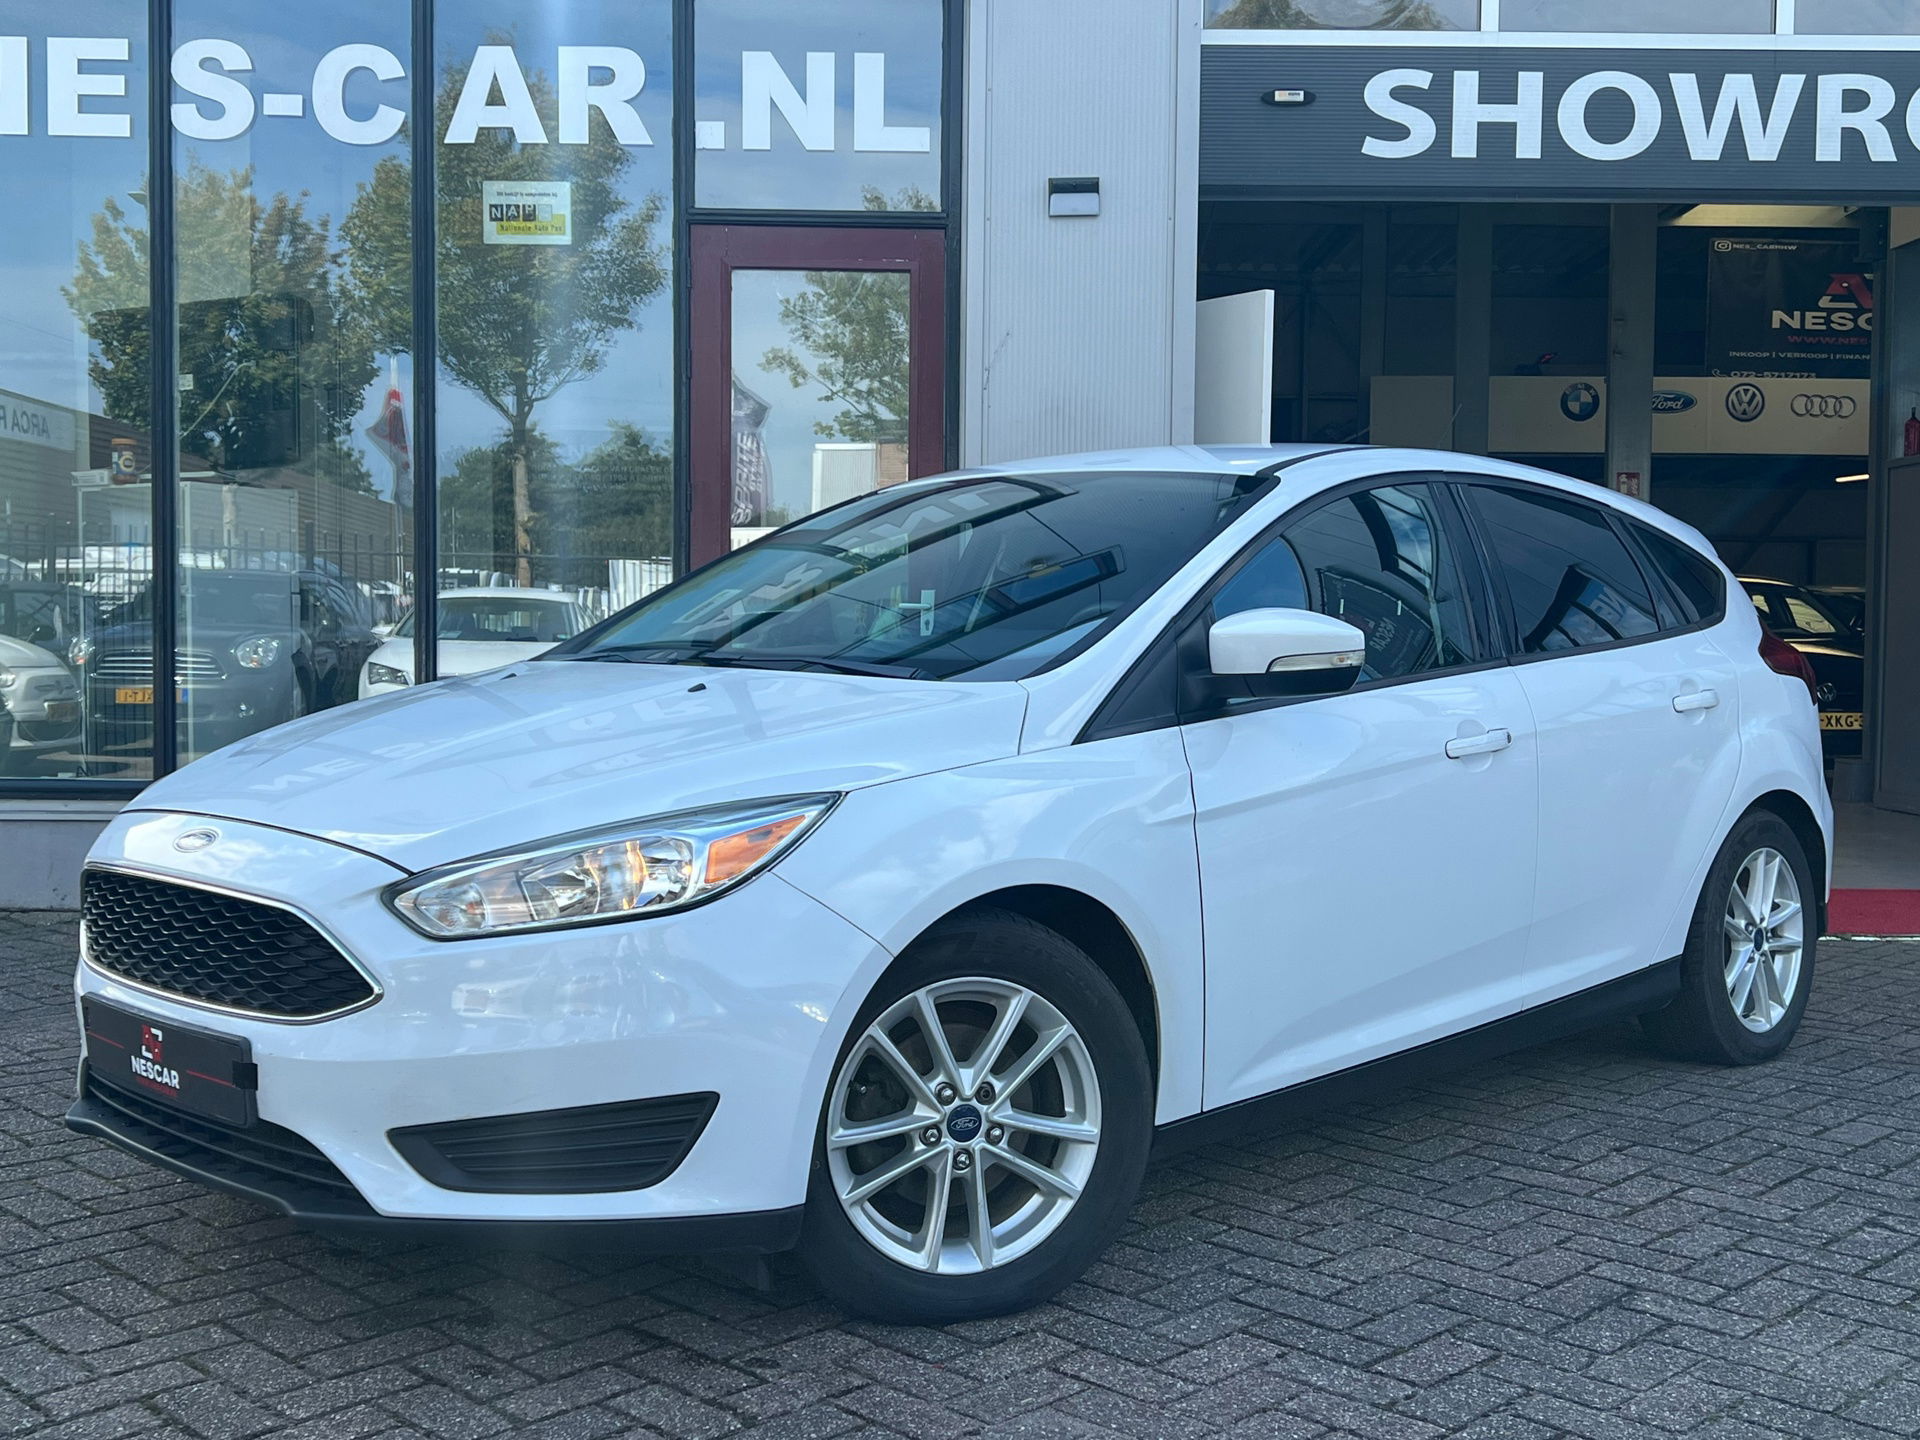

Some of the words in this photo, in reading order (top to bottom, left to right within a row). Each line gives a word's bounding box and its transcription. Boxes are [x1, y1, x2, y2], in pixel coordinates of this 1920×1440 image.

[1361, 68, 1920, 162] SHOWR
[491, 204, 534, 218] NAP
[1729, 351, 1770, 359] INKOOP
[1778, 351, 1829, 360] VERKOOP
[131, 1055, 180, 1089] NESCAR
